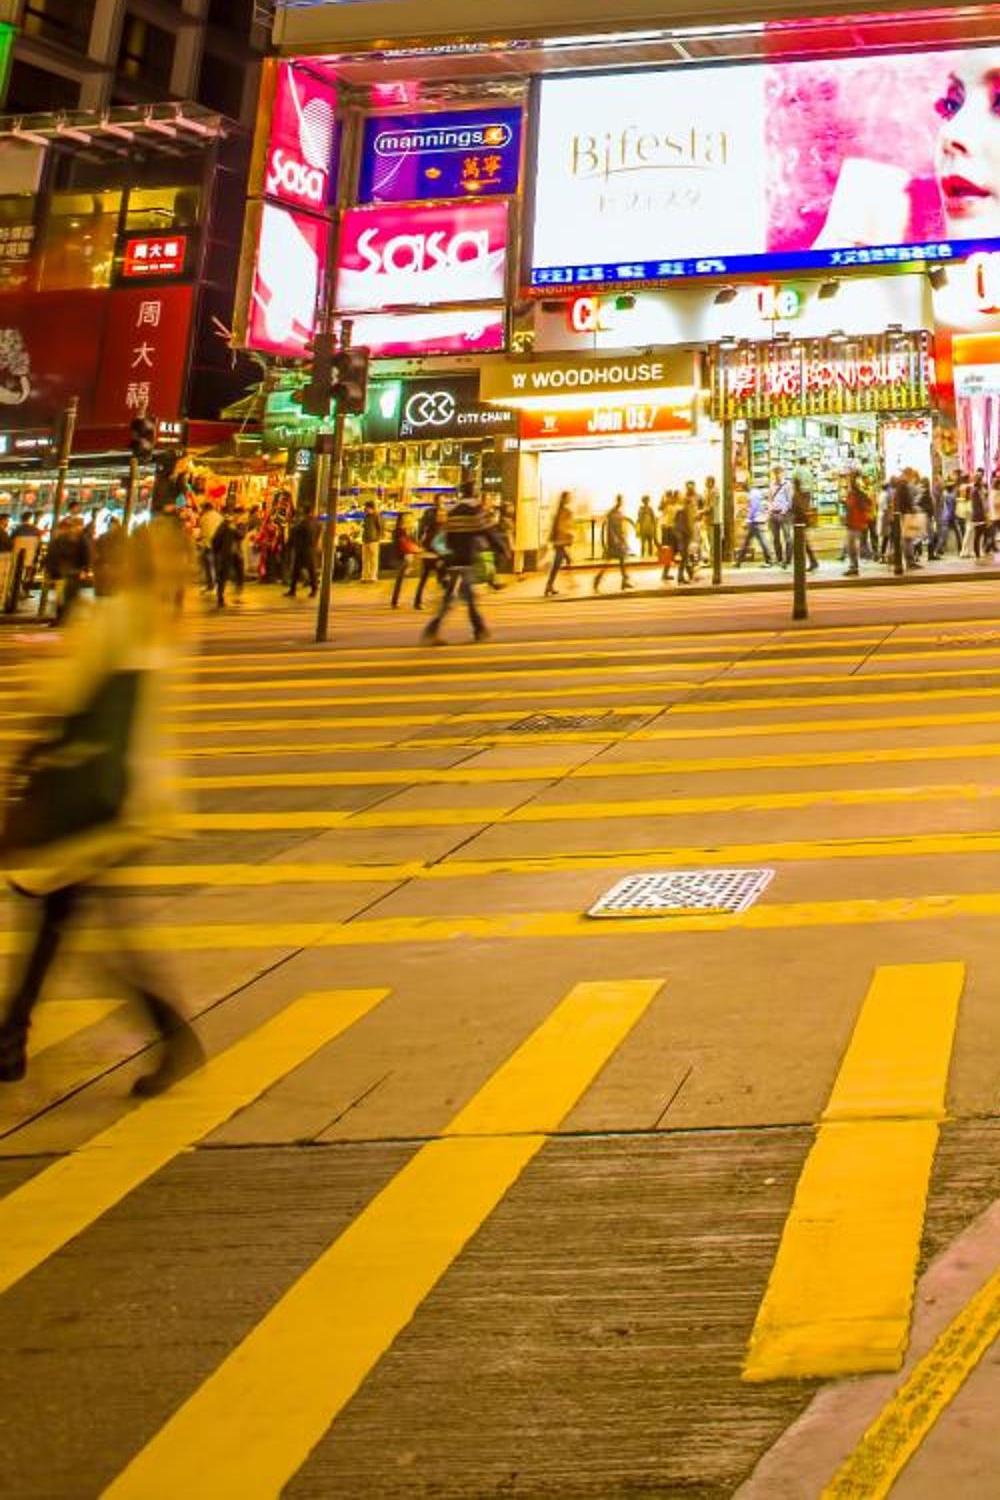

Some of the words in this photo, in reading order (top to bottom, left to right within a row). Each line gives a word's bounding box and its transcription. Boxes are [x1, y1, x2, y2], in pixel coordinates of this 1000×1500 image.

[378, 129, 483, 151] mannings
[570, 123, 728, 182] Bifesta
[126, 301, 161, 412] 周大福
[532, 363, 664, 388] WOODHOUSE
